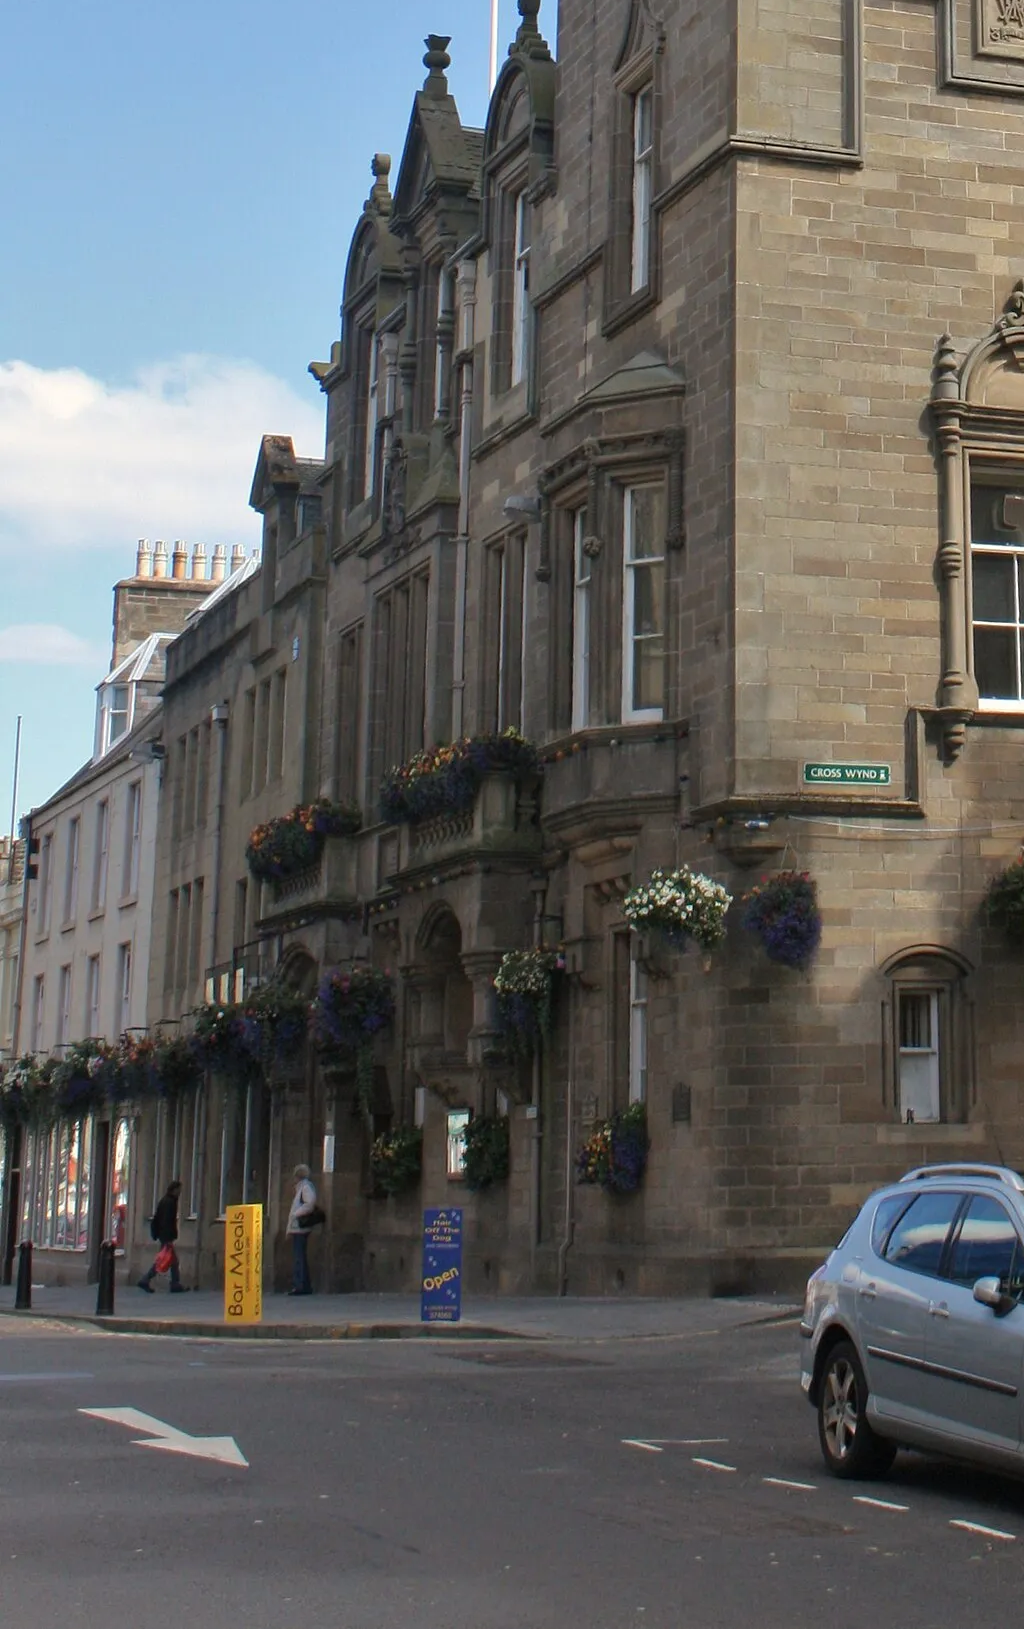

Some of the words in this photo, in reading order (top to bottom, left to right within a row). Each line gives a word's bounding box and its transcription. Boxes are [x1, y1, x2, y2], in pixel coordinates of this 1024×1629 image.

[810, 768, 842, 778] CROSS
[845, 769, 877, 779] WYND
[229, 1211, 245, 1276] Meals
[432, 1234, 452, 1242] Dog
[423, 1267, 459, 1290] Open
[228, 1282, 243, 1316] Bar
